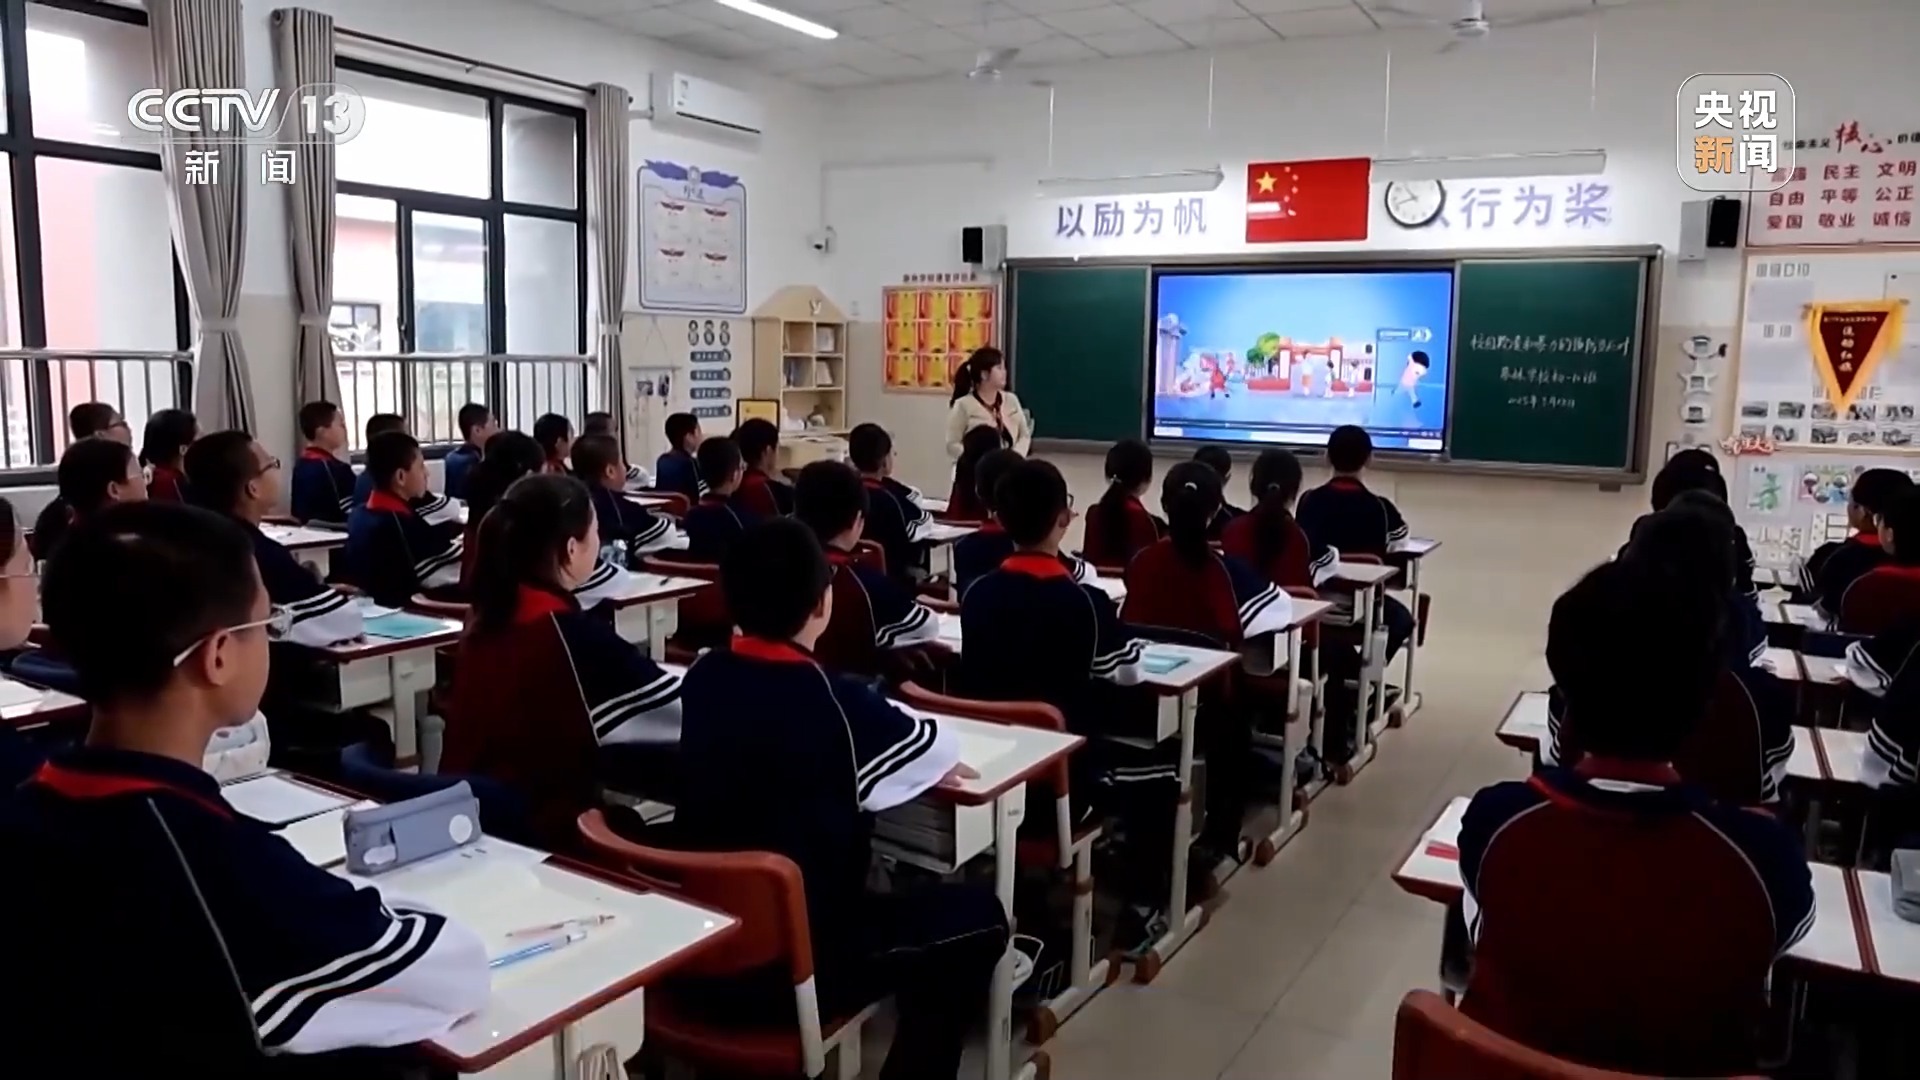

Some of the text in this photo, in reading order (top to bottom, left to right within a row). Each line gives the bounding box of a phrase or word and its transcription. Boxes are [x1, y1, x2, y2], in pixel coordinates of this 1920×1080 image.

[1823, 164, 1861, 180] 民主
[1877, 160, 1917, 178] 文明
[1438, 182, 1610, 230] 行为桨
[1769, 185, 1914, 206] 自由 平等 公正
[1056, 198, 1207, 238] 以励为帆
[1767, 211, 1912, 230] 爱国 敬业 诚信
